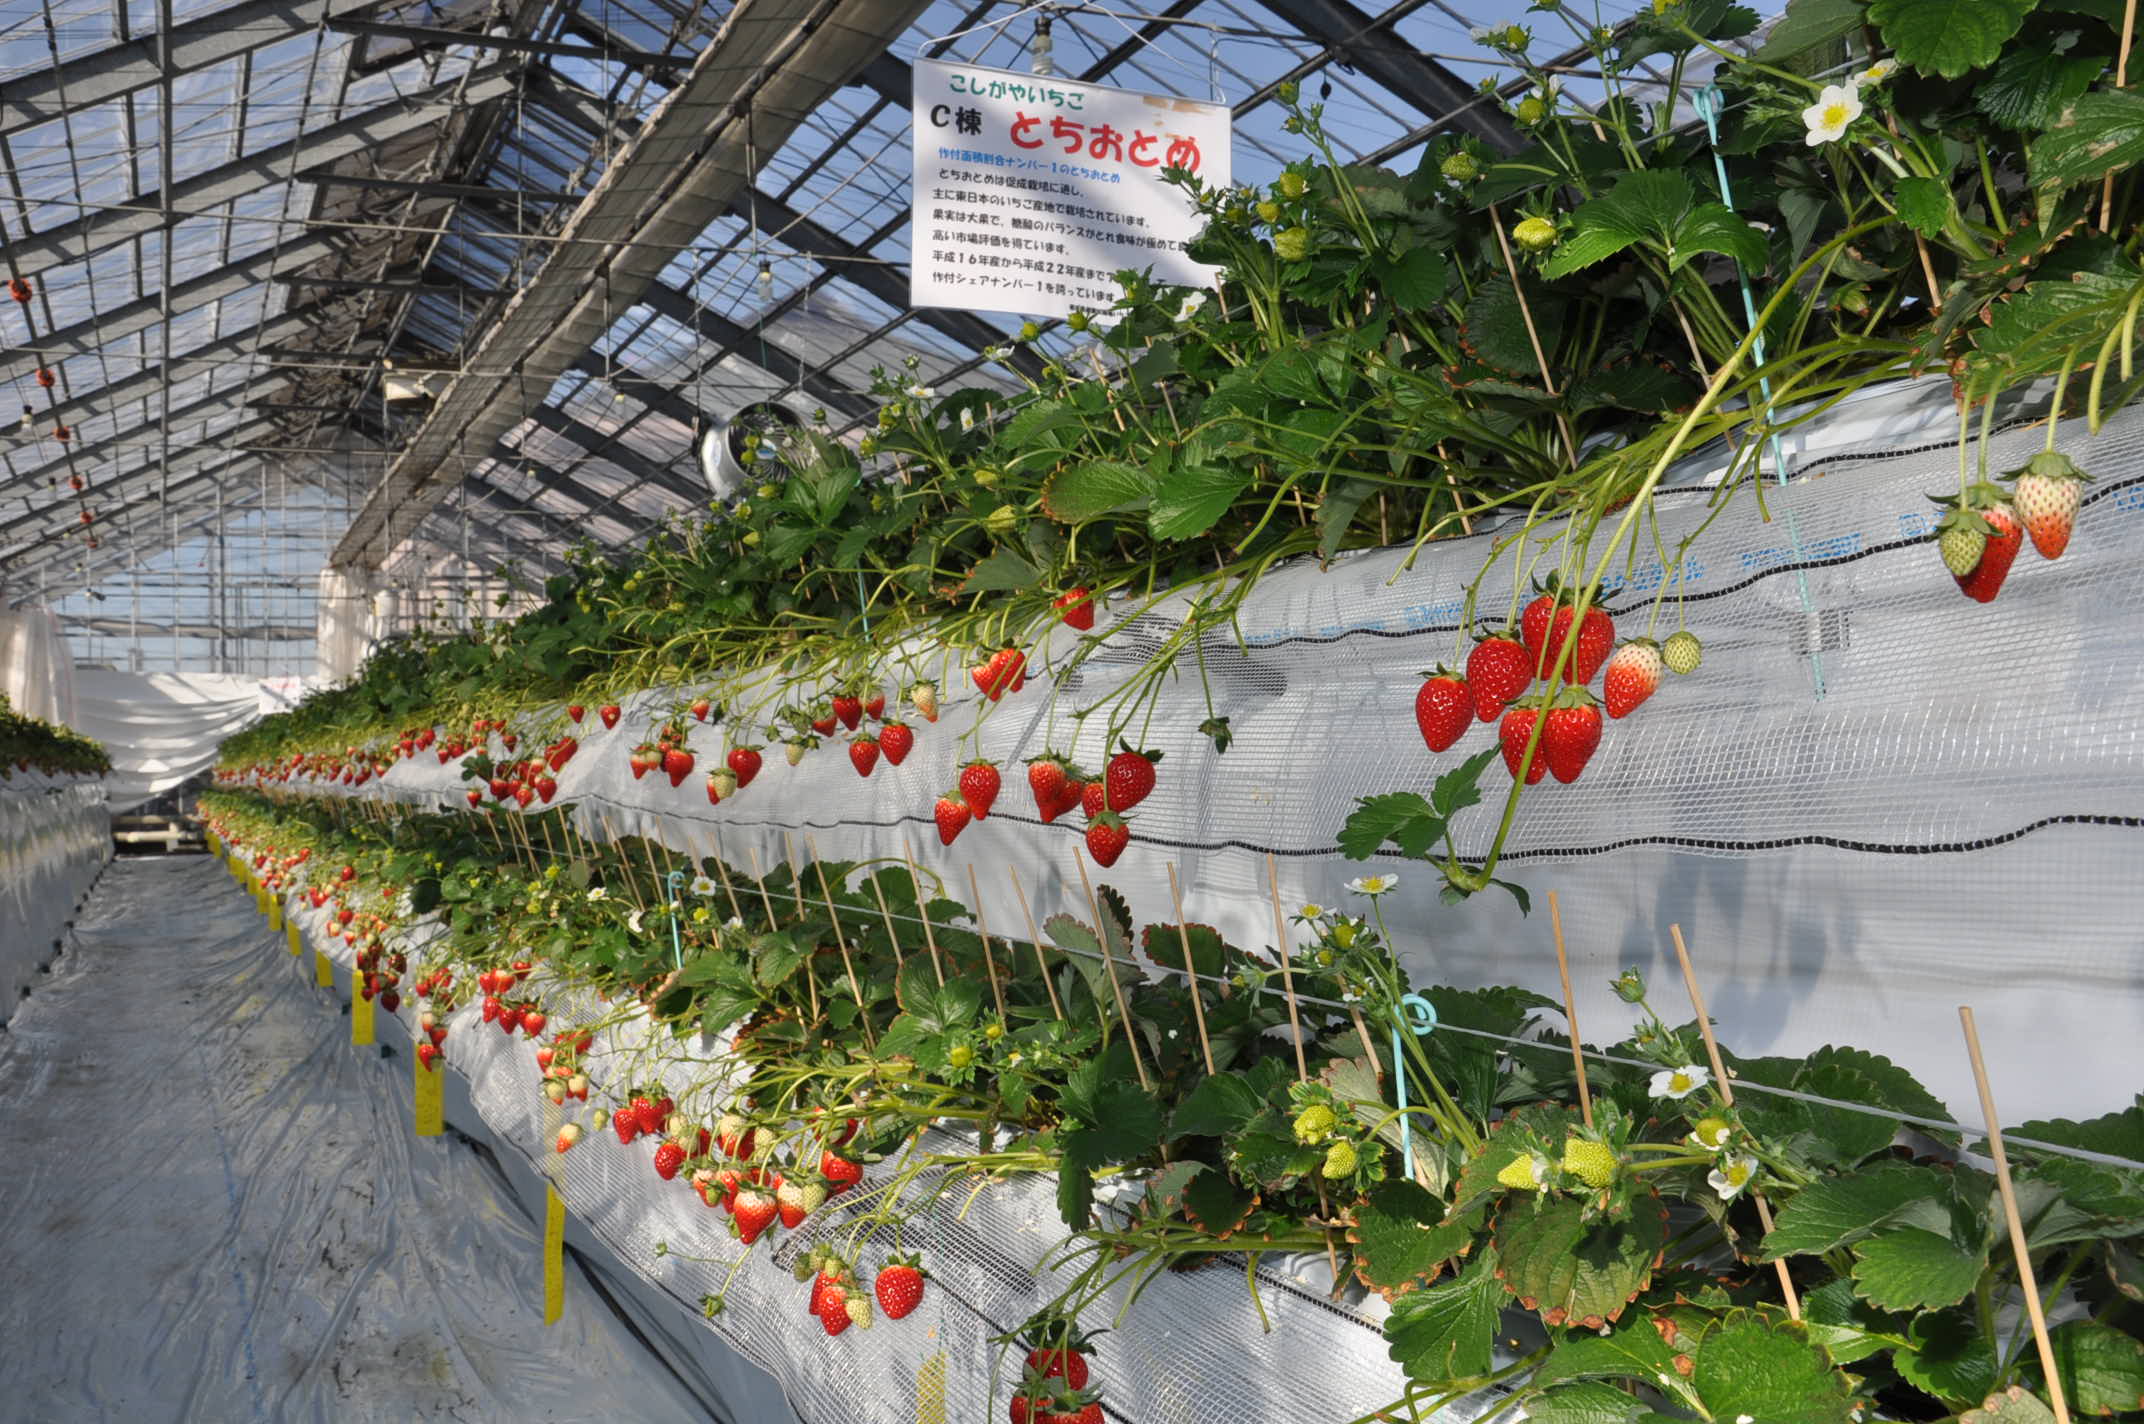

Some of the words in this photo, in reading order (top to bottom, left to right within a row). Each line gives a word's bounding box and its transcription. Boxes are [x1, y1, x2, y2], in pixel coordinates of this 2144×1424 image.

[950, 74, 1084, 110] こしがやいちご
[930, 103, 982, 136] C棟
[1009, 111, 1201, 173] とちおとめ
